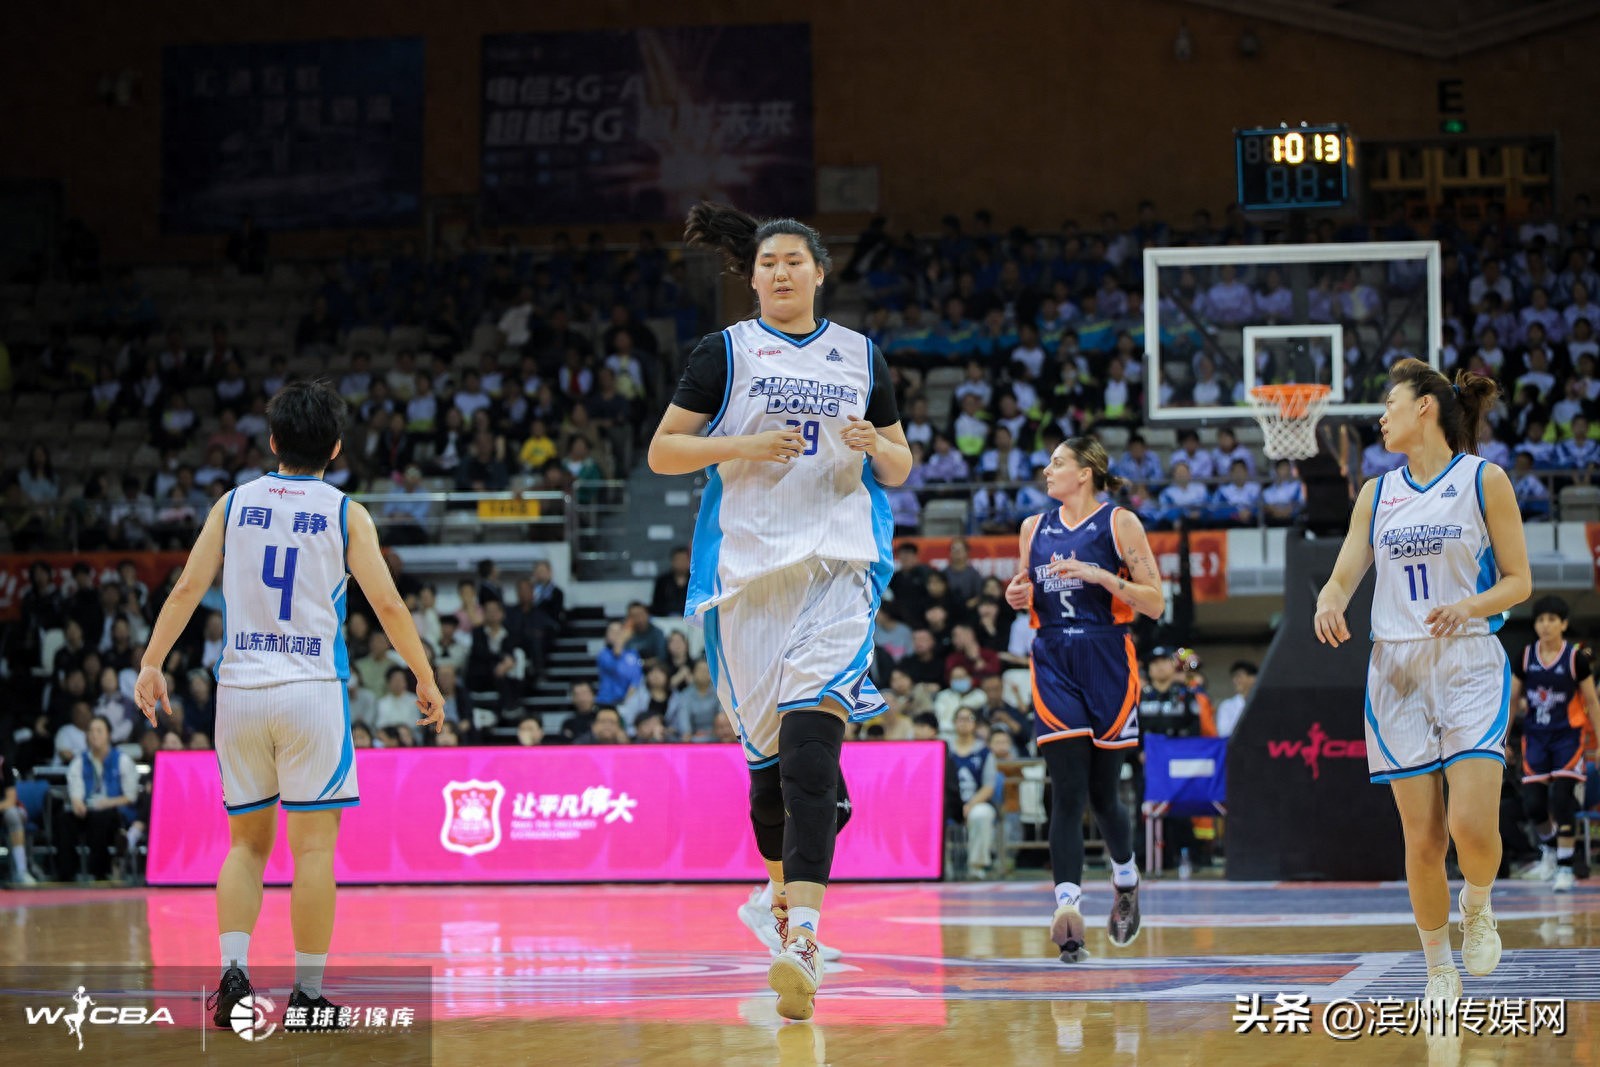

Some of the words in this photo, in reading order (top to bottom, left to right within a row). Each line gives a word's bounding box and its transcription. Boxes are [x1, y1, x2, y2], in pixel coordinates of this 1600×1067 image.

[1438, 80, 1464, 112] E
[637, 100, 794, 141] 未来
[749, 376, 819, 397] SHAN
[766, 395, 839, 417] DONG
[238, 506, 327, 535] 周静
[1390, 538, 1442, 560] DONG
[262, 545, 299, 621] 4
[1404, 563, 1429, 601] 11
[1060, 590, 1076, 618] 5
[235, 631, 322, 657] 山东赤水河酒
[512, 785, 638, 824] 让平凡伟大
